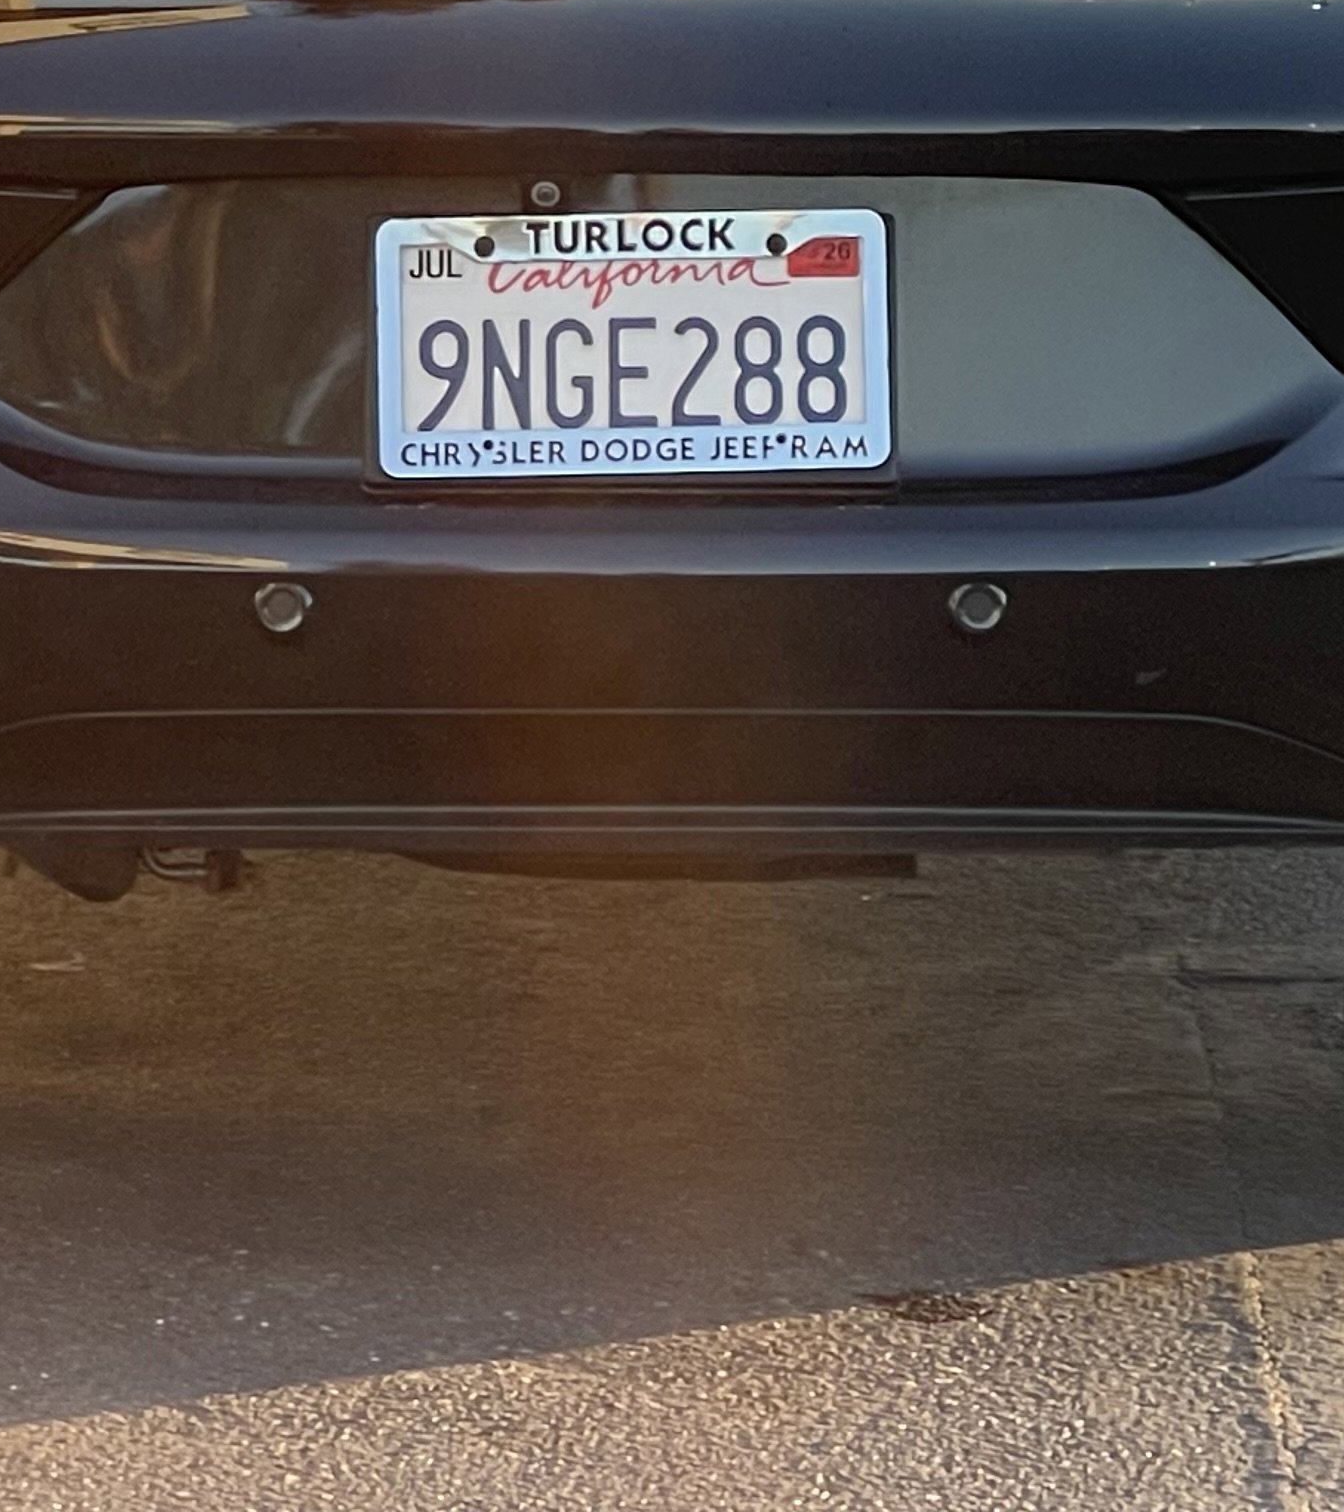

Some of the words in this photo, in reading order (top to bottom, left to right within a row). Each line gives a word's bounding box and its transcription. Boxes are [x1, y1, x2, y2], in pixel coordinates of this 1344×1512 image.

[526, 218, 735, 255] TURLOCK
[409, 249, 462, 278] JUL
[417, 314, 848, 432] 9NGE288
[581, 438, 695, 463] DODGE
[791, 434, 869, 459] RAM
